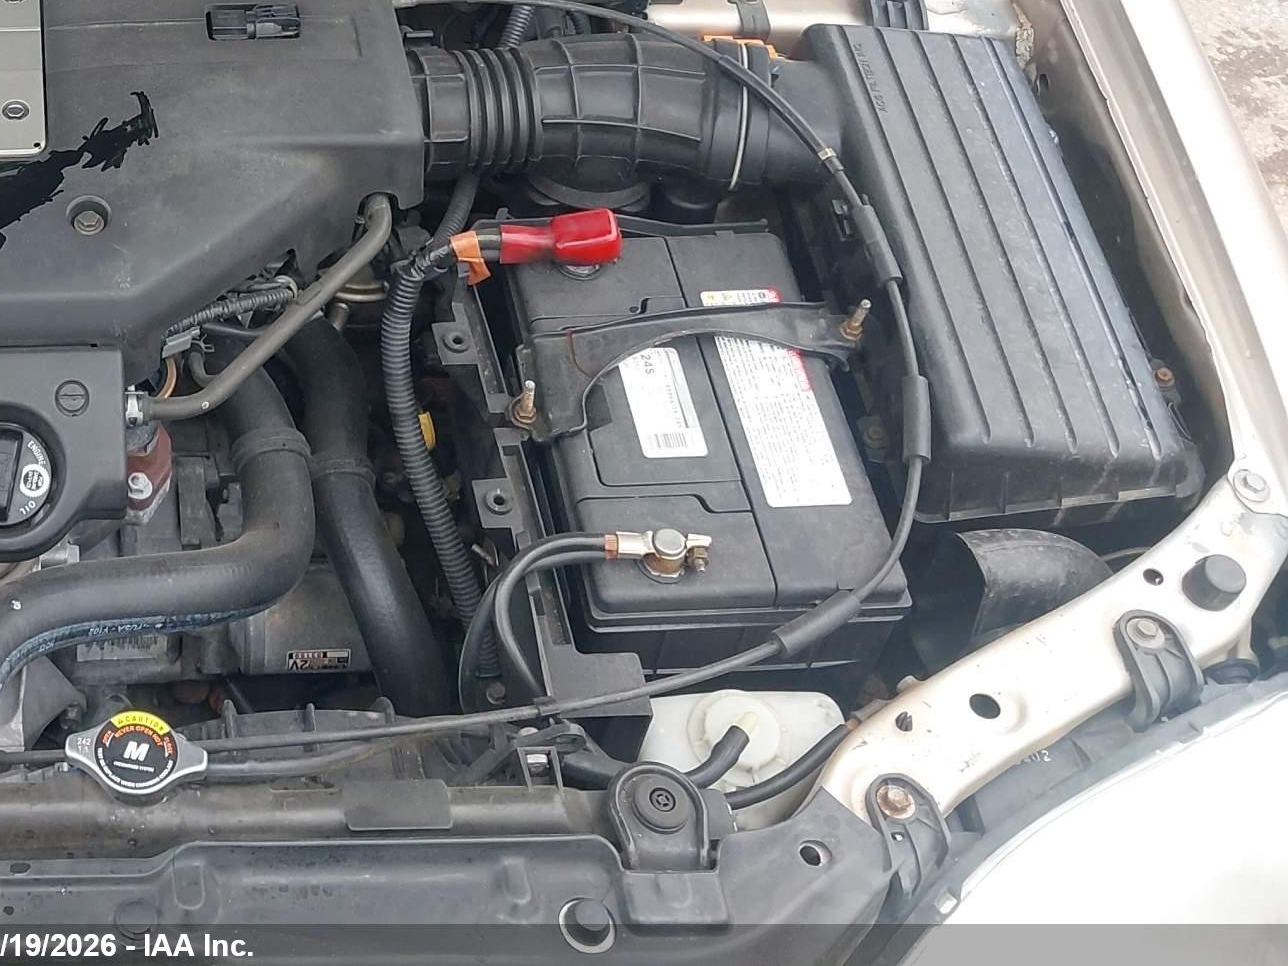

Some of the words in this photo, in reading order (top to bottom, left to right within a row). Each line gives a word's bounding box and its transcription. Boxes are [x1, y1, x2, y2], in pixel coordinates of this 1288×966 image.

[28, 441, 47, 467] ENGINE
[19, 500, 37, 516] OIL
[125, 716, 165, 732] CAUTION
[114, 725, 135, 739] NEVER
[135, 725, 154, 737] OPEN
[152, 733, 163, 747] HOT
[123, 740, 150, 762] M
